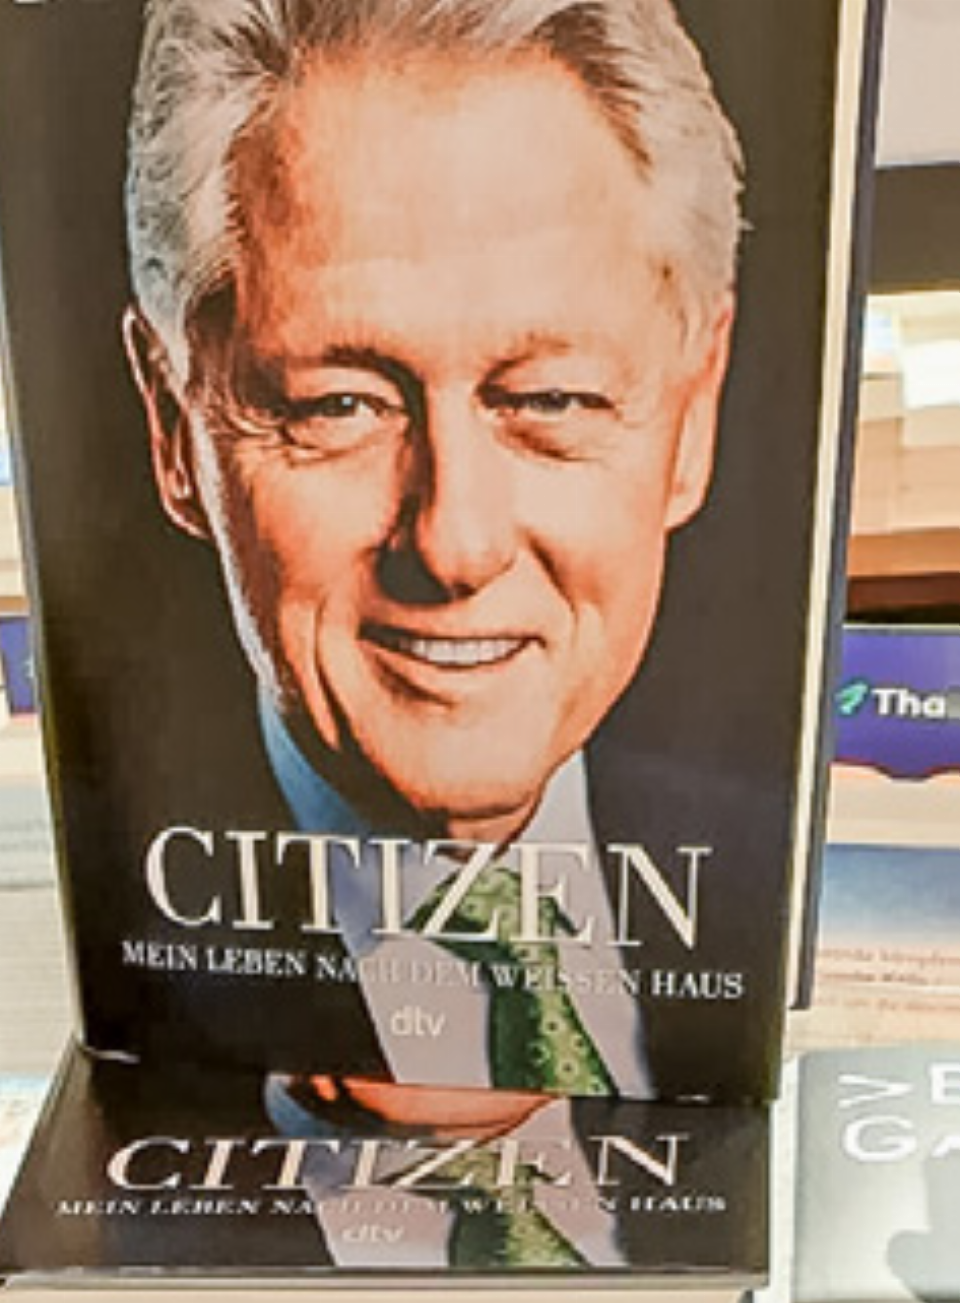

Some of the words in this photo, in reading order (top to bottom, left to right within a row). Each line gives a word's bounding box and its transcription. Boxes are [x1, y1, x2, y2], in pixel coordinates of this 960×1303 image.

[146, 826, 714, 949] CITIZEN
[121, 939, 198, 972] MEIN
[206, 946, 306, 977] LEBEN
[650, 967, 744, 999] HAUS
[391, 1005, 446, 1037] dtv
[106, 1136, 690, 1191] CITIZEN
[56, 1199, 139, 1216] MEIN
[150, 1198, 259, 1216] LEBEN
[630, 1195, 726, 1213] HAUS
[341, 1223, 404, 1244] dtv
